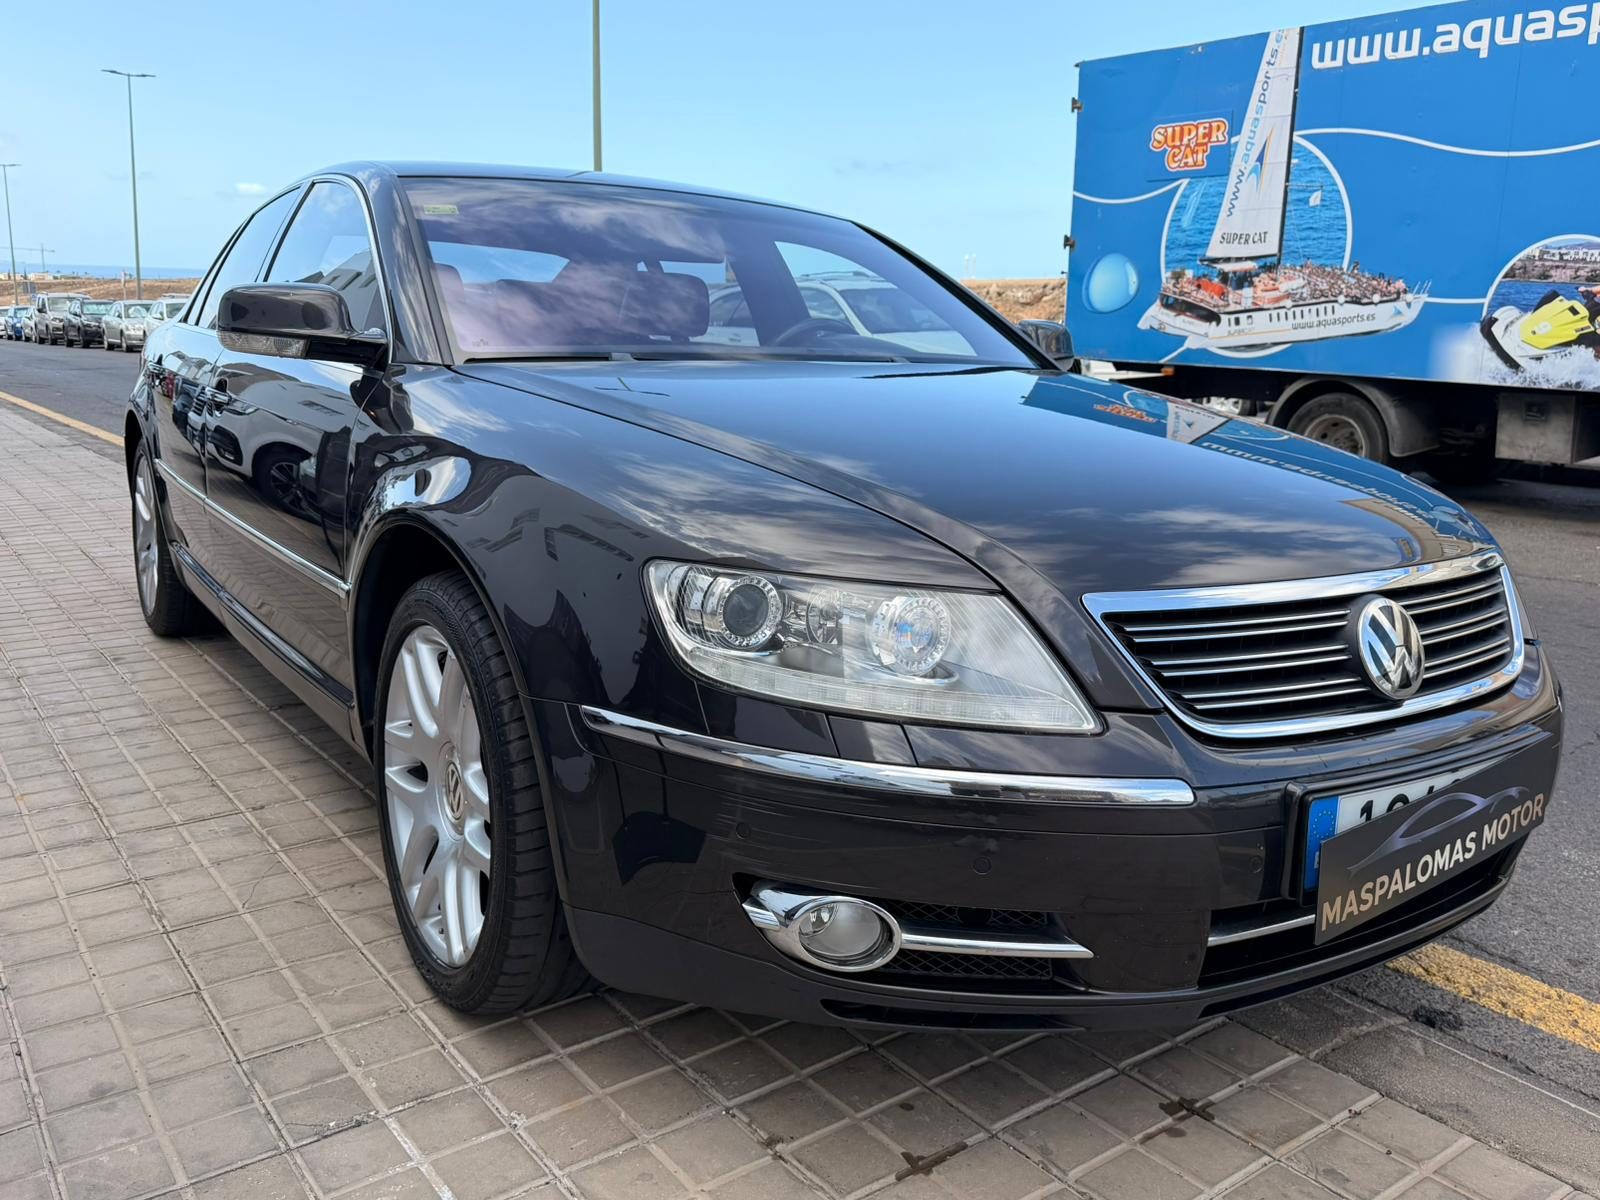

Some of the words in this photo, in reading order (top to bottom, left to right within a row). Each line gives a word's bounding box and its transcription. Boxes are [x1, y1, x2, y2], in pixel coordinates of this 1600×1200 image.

[1151, 119, 1228, 151] SUPER
[1166, 143, 1208, 170] CAT
[1219, 231, 1251, 245] SUPER
[1252, 231, 1269, 244] CAT
[1291, 313, 1376, 330] www.aquasports.es
[1321, 830, 1477, 931] MASPALOMAS
[1481, 792, 1545, 852] MOTOR
